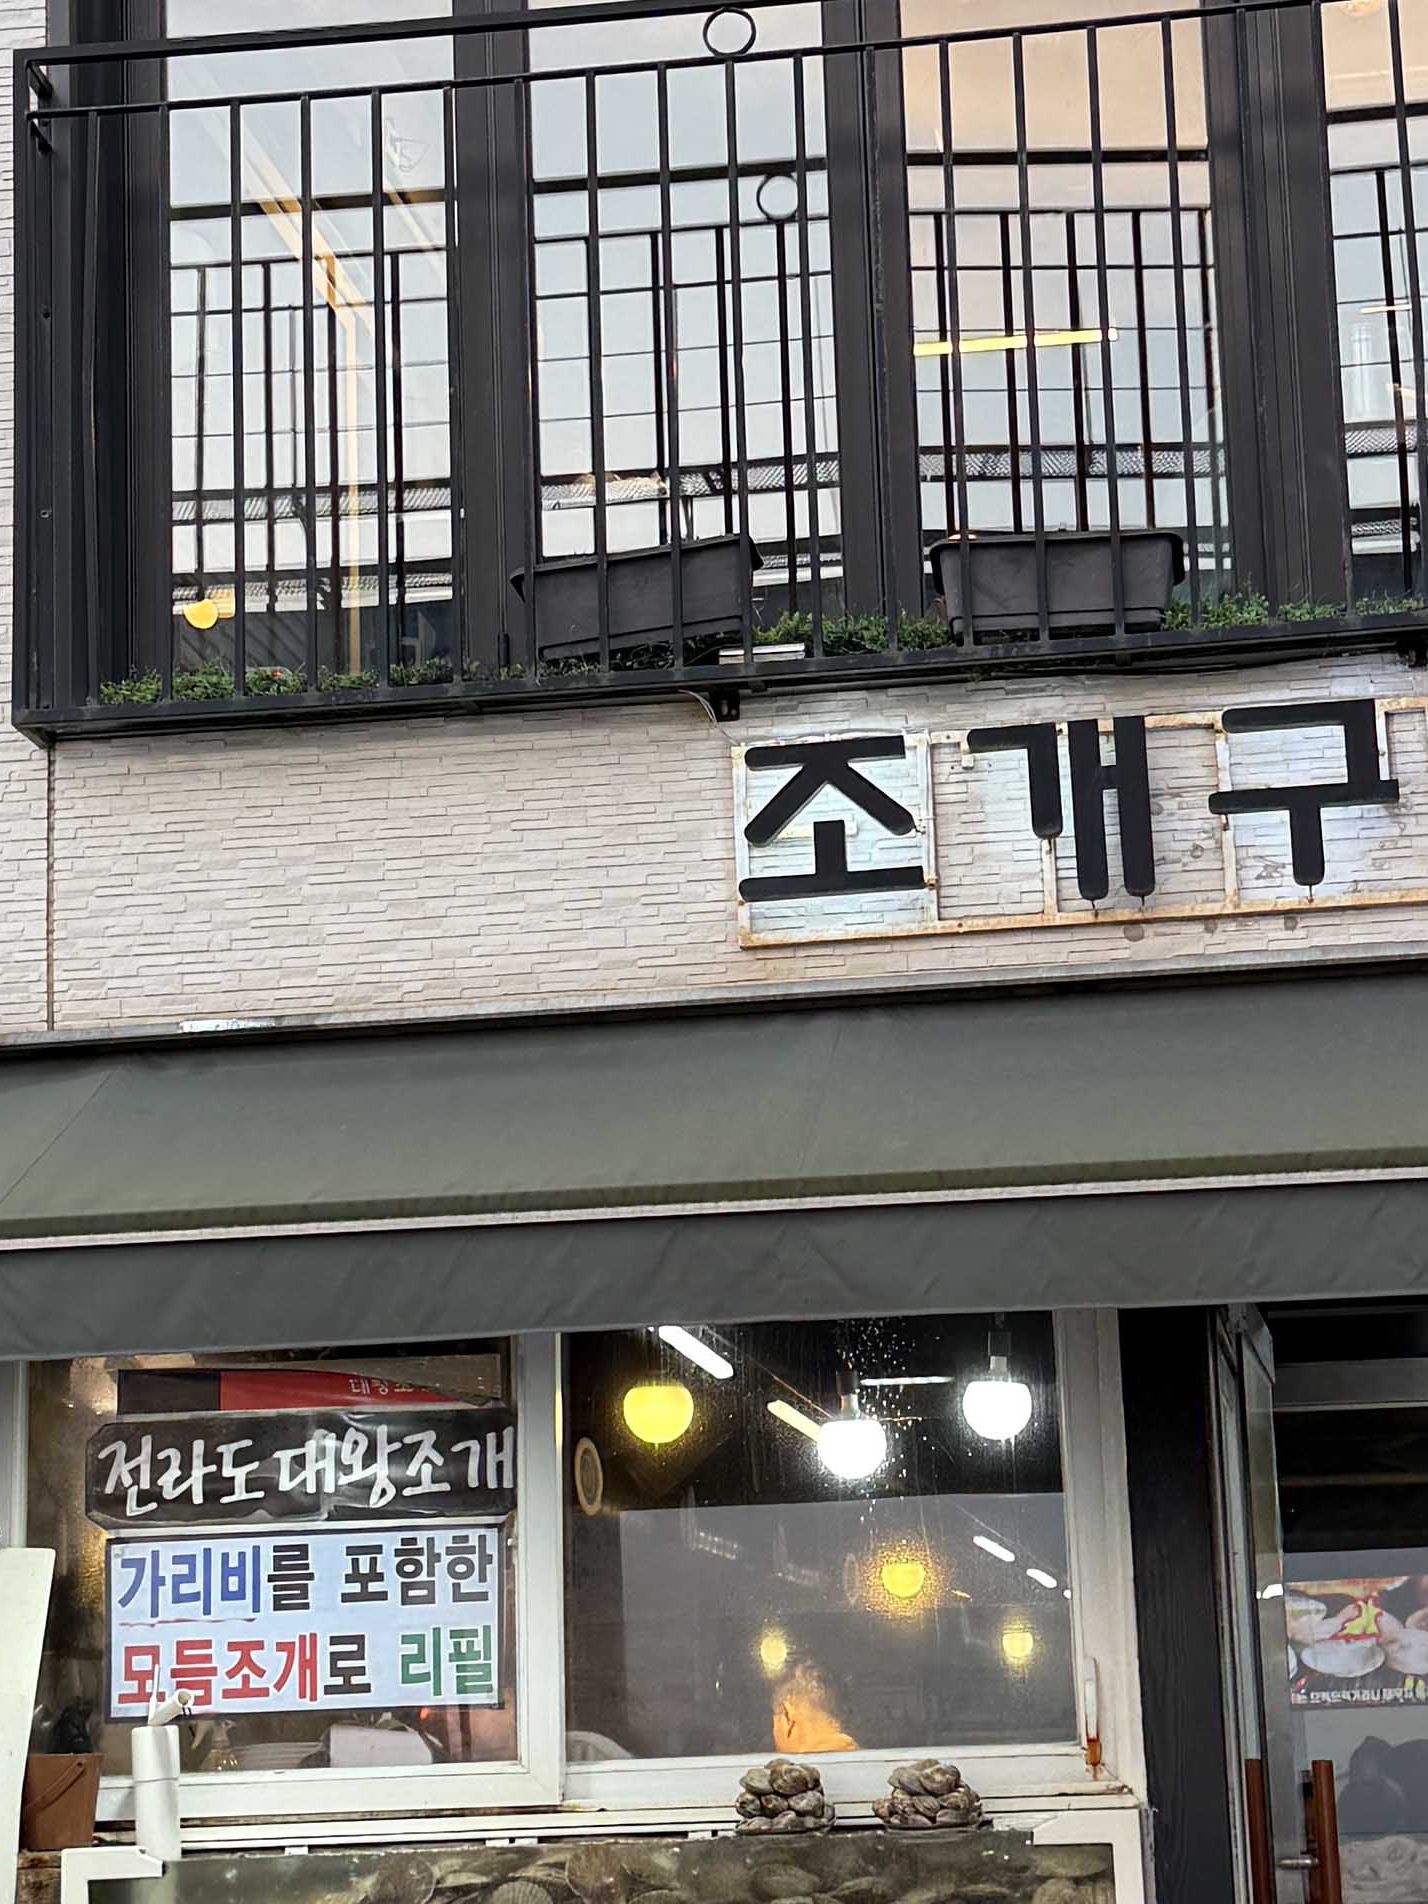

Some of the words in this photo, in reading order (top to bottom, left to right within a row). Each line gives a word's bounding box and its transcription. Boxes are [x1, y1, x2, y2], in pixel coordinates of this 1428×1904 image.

[97, 1424, 516, 1517] 전라도대왕조개
[117, 1543, 315, 1619] 가리비를
[340, 1533, 494, 1606] 포함한
[117, 1631, 373, 1706] 모듬조개로
[400, 1625, 494, 1697] 리필
